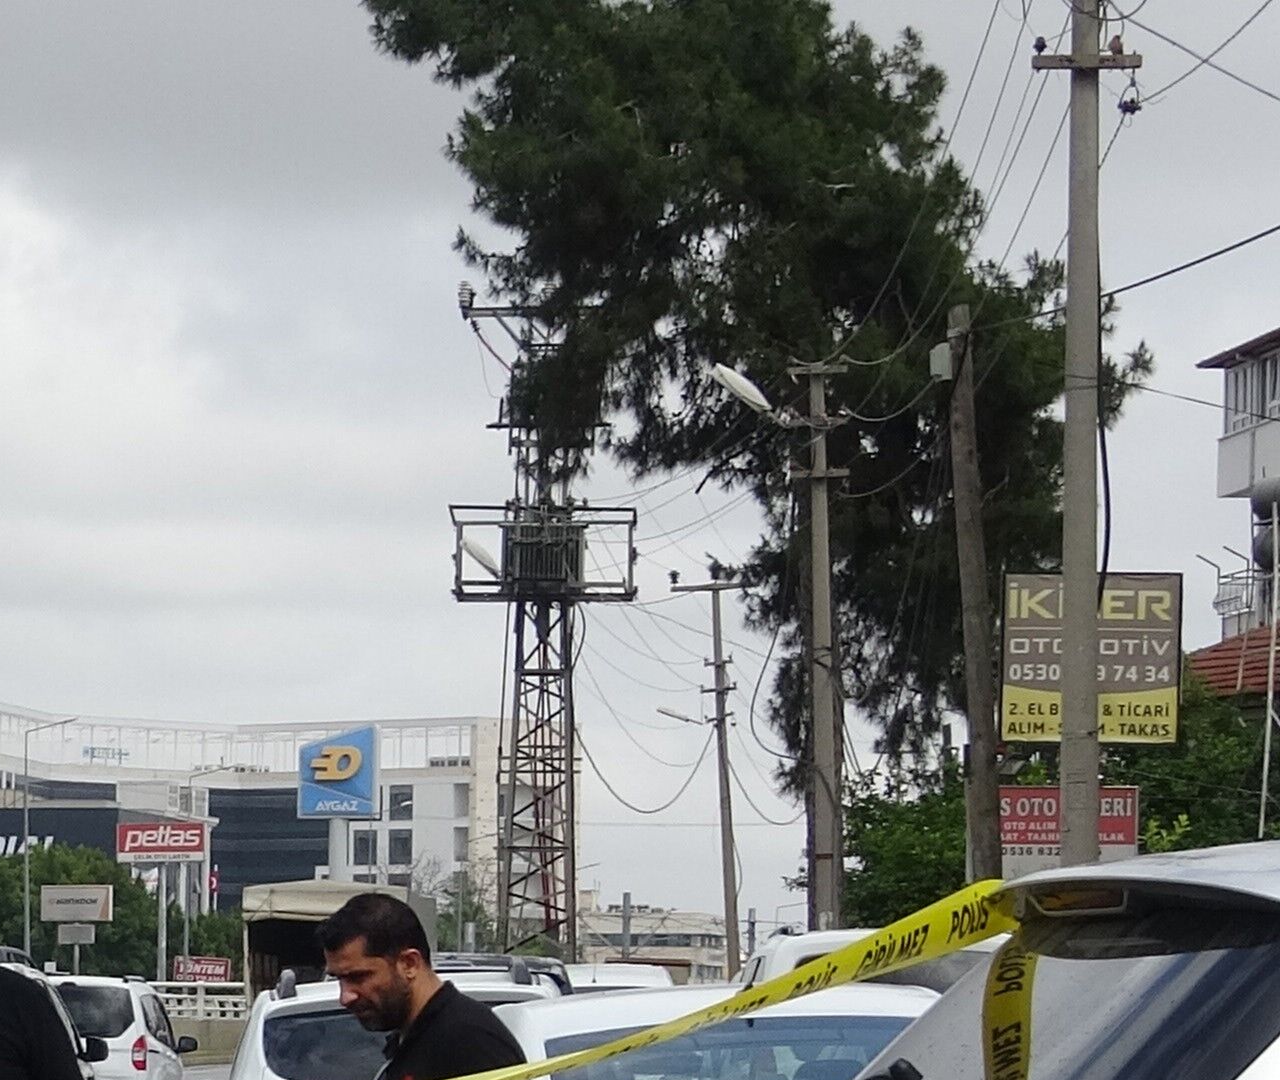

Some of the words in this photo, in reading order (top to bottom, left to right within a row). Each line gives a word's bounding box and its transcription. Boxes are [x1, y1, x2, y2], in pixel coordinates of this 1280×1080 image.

[1009, 582, 1172, 620] İKİER
[1009, 635, 1171, 656] OTOTİV
[1009, 664, 1060, 681] 0530
[1113, 666, 1137, 682] 74
[1144, 666, 1170, 682] 34
[1009, 703, 1024, 716] 2.
[1028, 704, 1044, 716] EL
[1103, 705, 1113, 716] &
[1118, 702, 1170, 717] TİCARİ
[1007, 722, 1045, 735] ALIM
[1119, 723, 1171, 737] TAKAS
[315, 799, 359, 812] AYGAZ
[1016, 798, 1057, 816] OTO
[1100, 793, 1132, 817] ERİ
[1003, 821, 1027, 830] OTO
[1028, 821, 1056, 830] ALIM
[124, 825, 201, 852] petlas
[947, 892, 990, 944] POLİS
